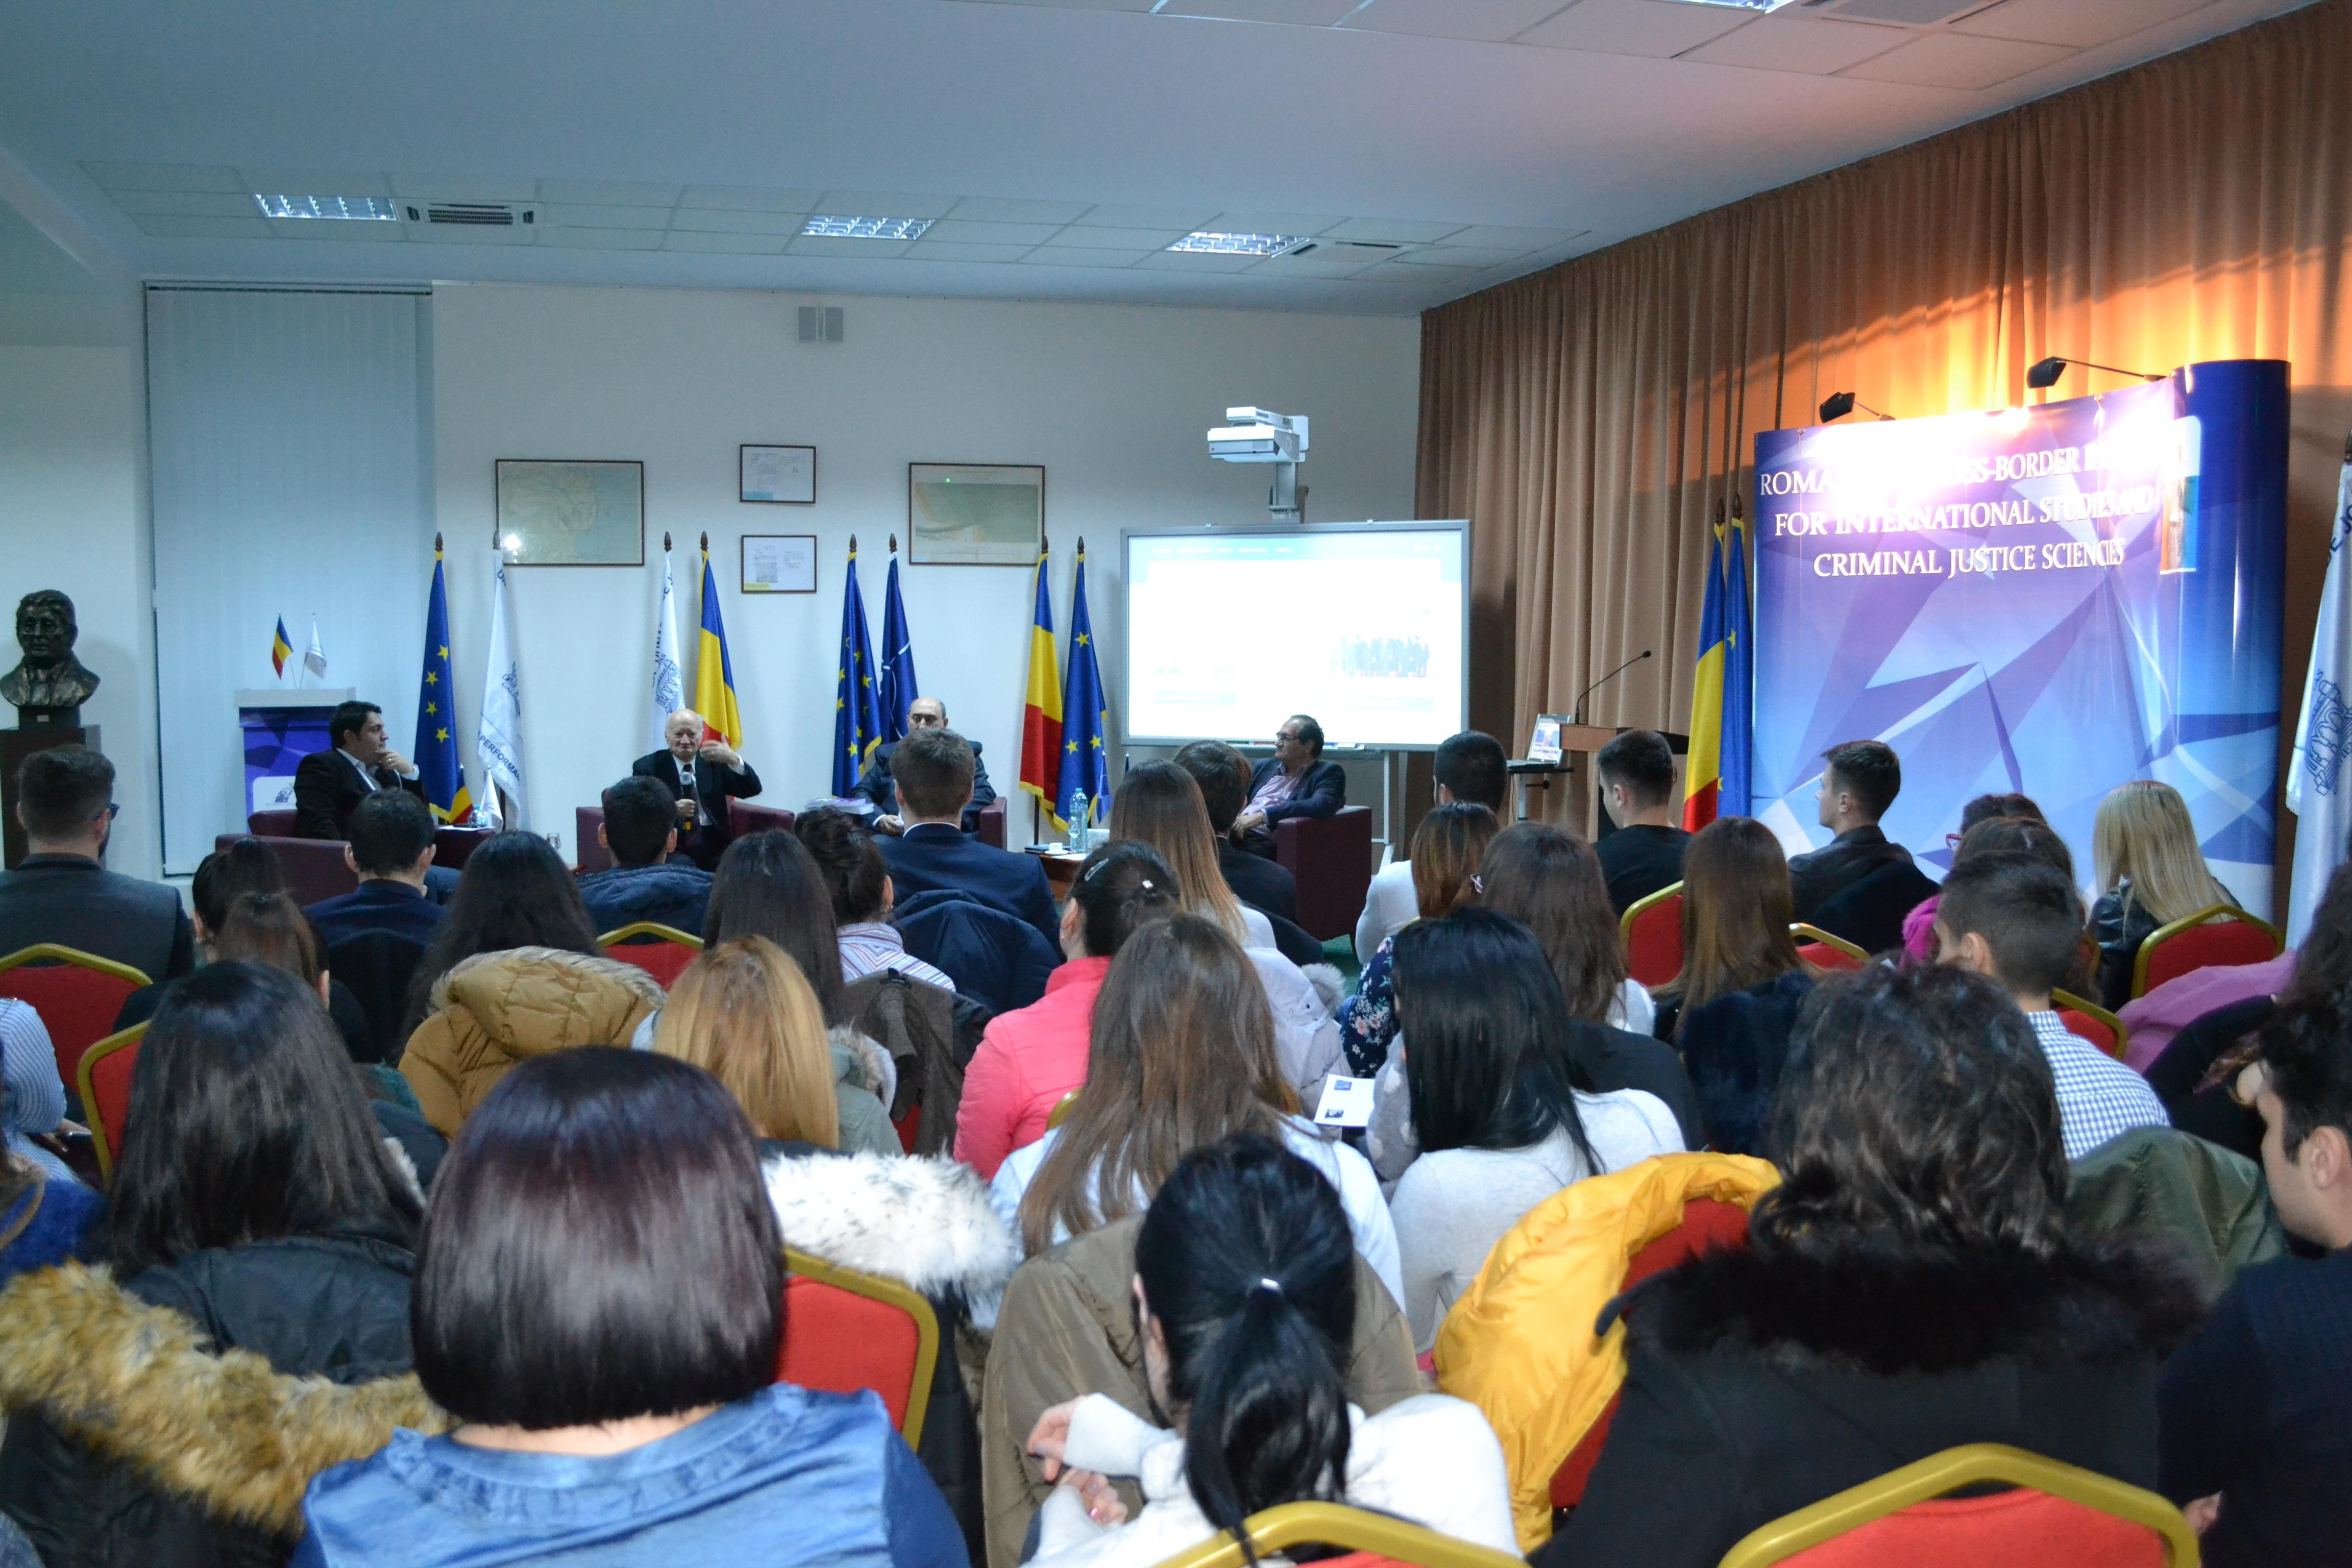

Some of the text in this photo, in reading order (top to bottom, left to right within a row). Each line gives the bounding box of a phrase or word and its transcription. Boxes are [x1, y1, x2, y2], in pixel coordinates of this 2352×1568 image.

[1775, 511, 1827, 536] FOR
[1835, 499, 2035, 534] INTERNATIONAL
[2039, 489, 2115, 523] STUDIES
[1814, 538, 2125, 579] CRIMINAL JUSTICE SCIENCIES
